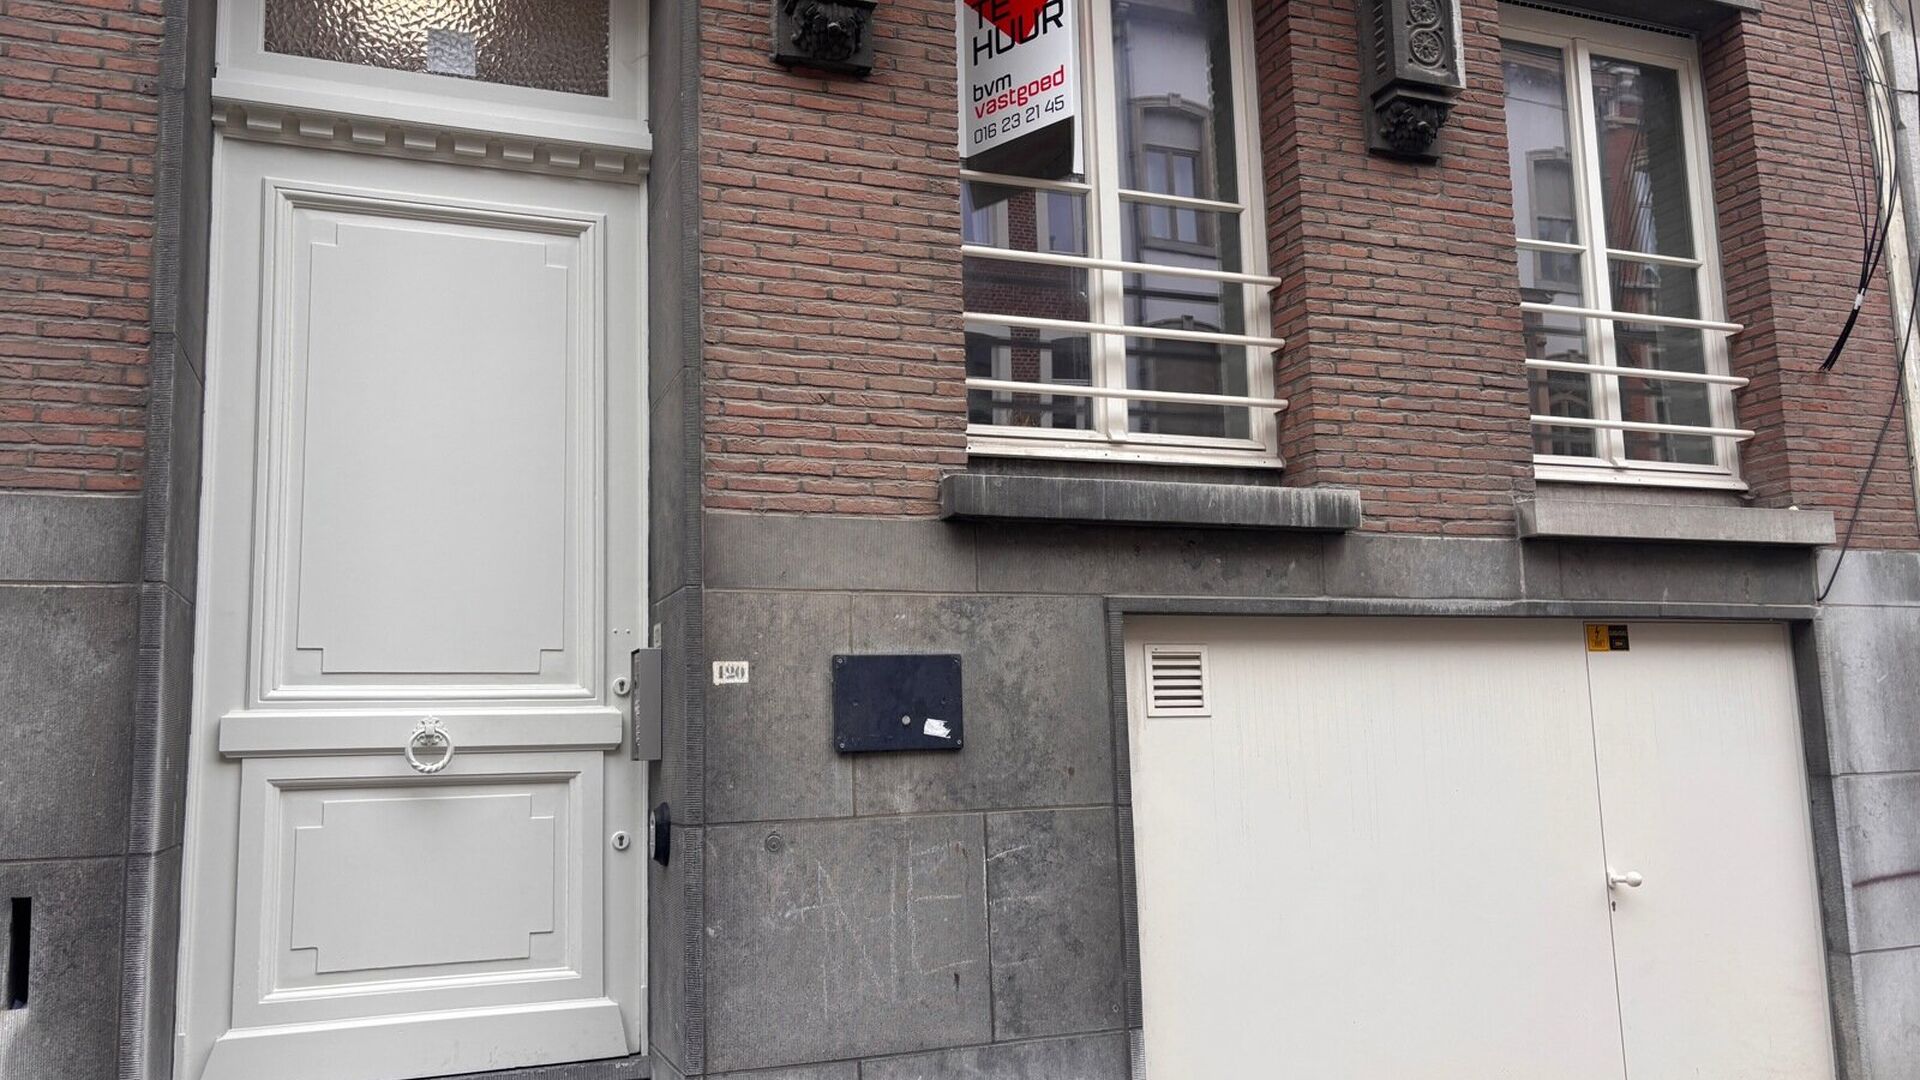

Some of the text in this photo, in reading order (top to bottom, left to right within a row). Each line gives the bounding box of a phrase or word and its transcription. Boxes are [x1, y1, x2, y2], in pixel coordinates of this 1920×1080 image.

[971, 0, 1011, 29] TE
[973, 0, 1064, 66] HUUR
[974, 74, 1012, 102] bvm
[975, 64, 1064, 118] vastgoed
[974, 94, 1065, 144] 016 23 21 45
